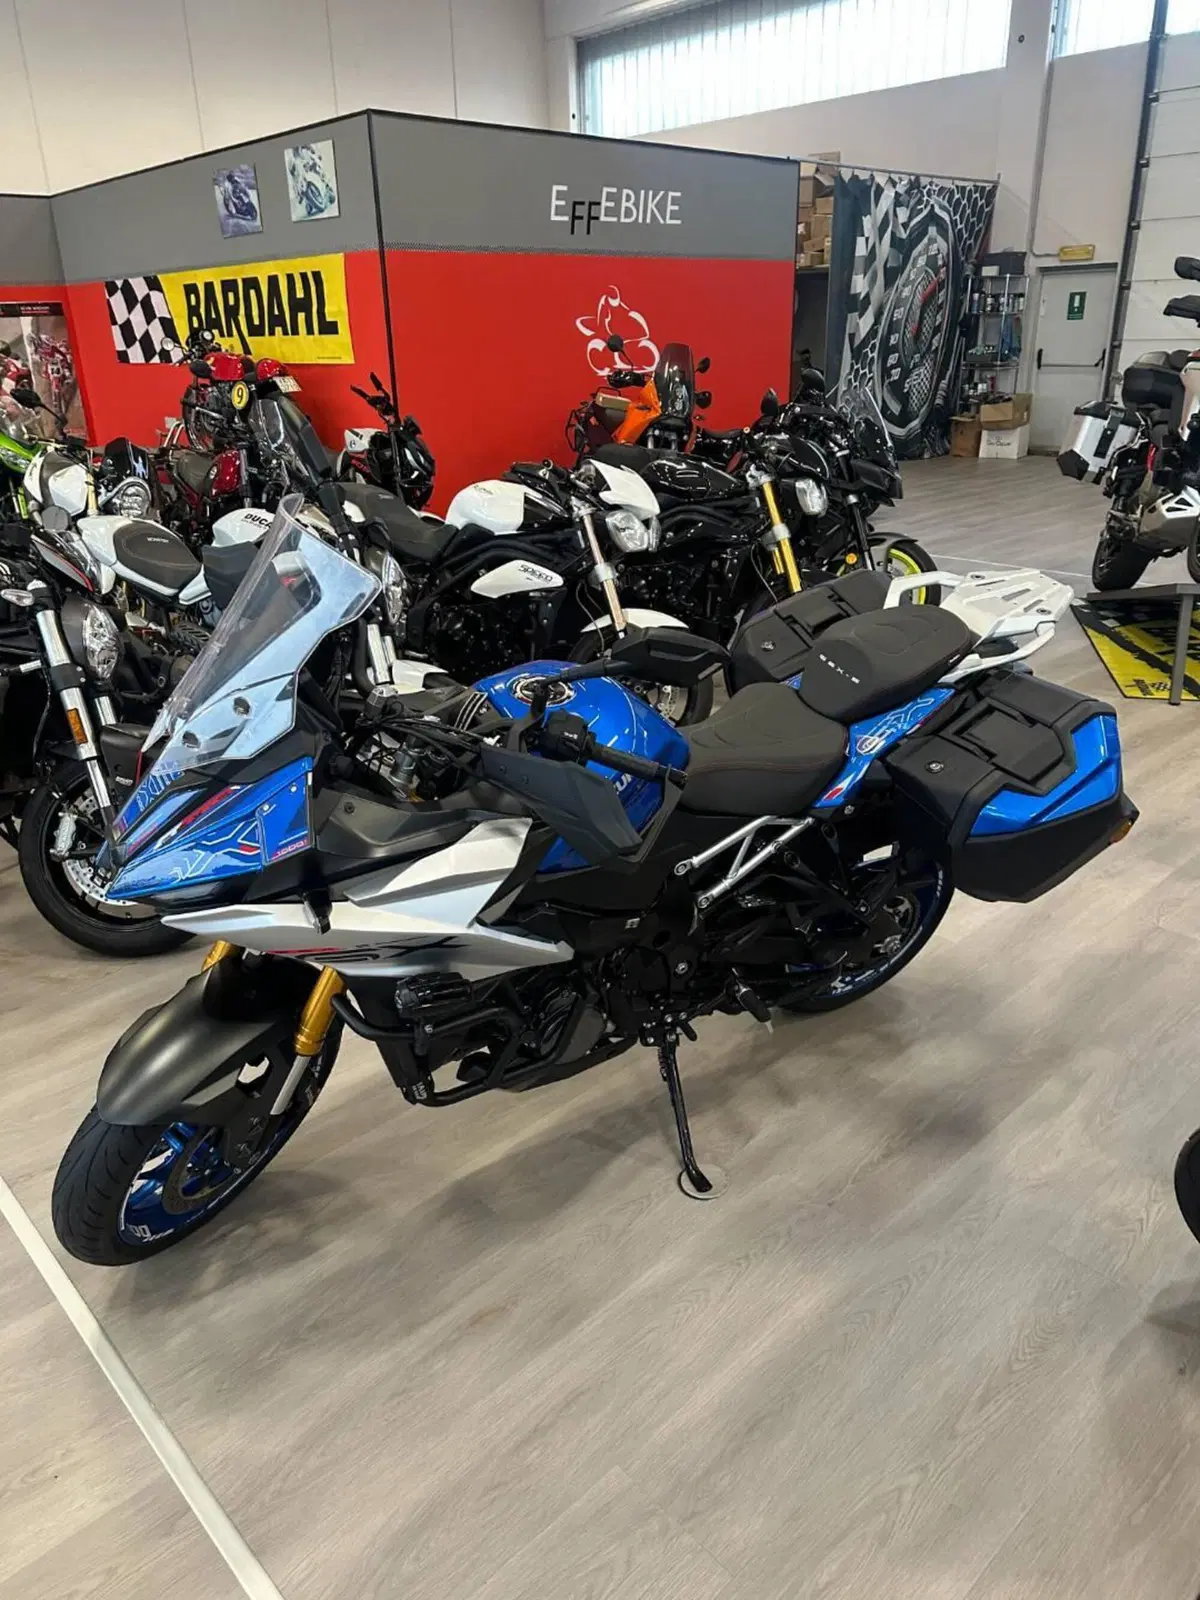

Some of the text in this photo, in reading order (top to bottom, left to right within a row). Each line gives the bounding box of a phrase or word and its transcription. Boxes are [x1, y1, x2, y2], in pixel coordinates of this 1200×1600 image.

[550, 185, 682, 235] EFFEBIKE
[183, 270, 339, 355] BARDAHL
[244, 513, 273, 528] DUCA
